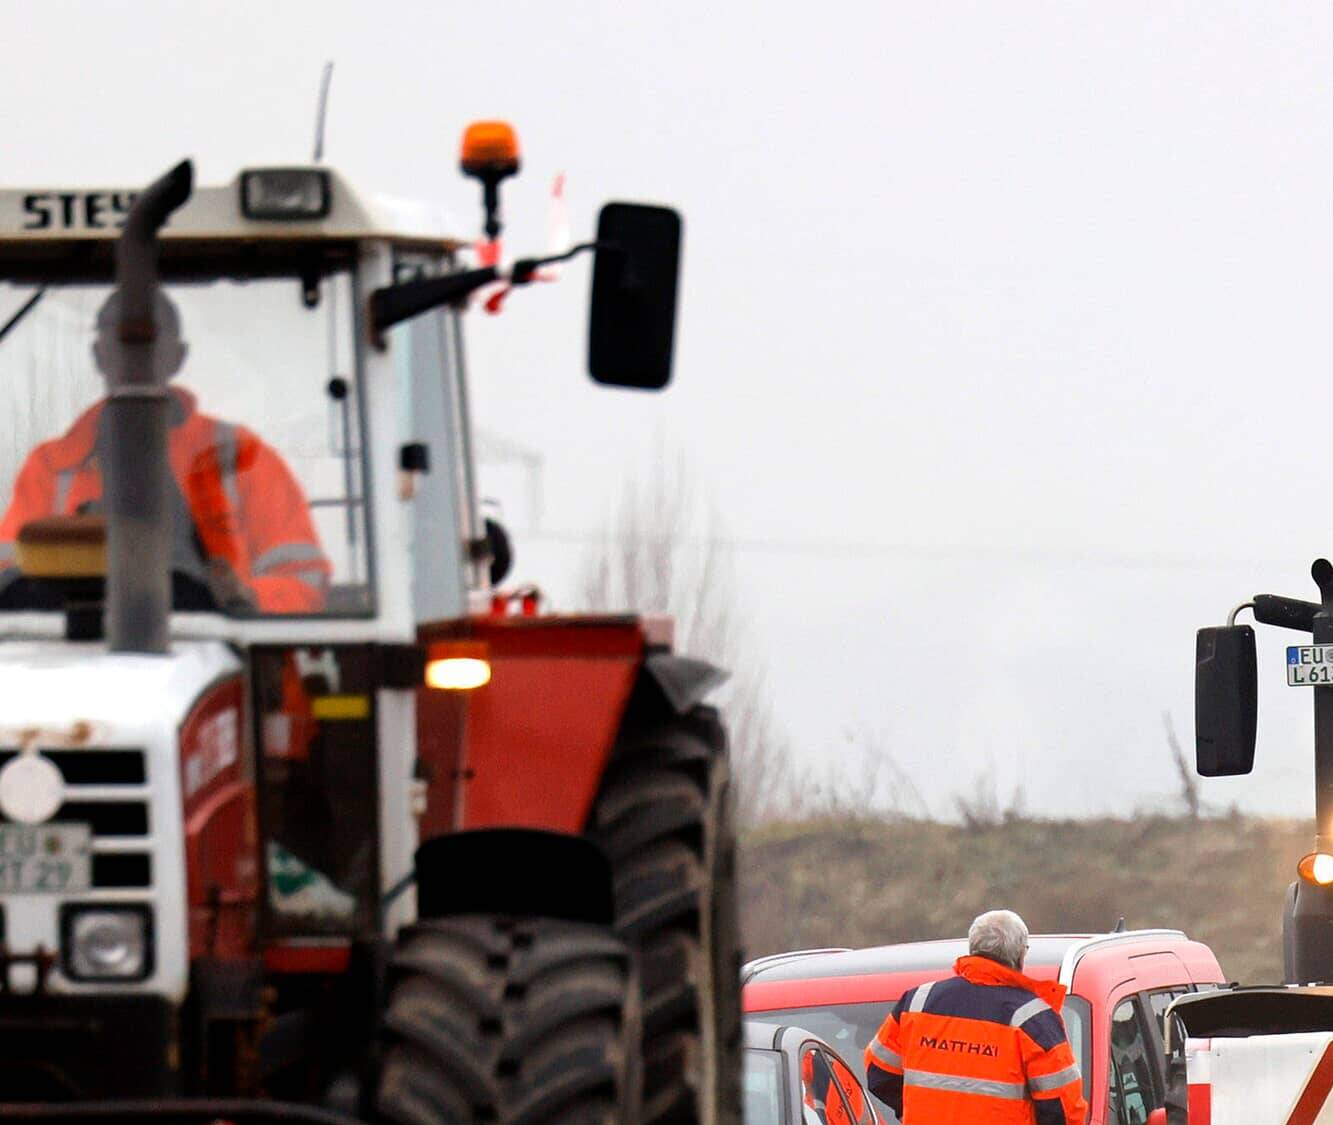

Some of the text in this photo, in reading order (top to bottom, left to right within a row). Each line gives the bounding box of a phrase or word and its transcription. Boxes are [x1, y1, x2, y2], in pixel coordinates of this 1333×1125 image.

[23, 192, 146, 230] STEY
[1300, 648, 1323, 664] EU
[1294, 667, 1304, 683] L
[920, 1036, 999, 1057] MATTHÄI
